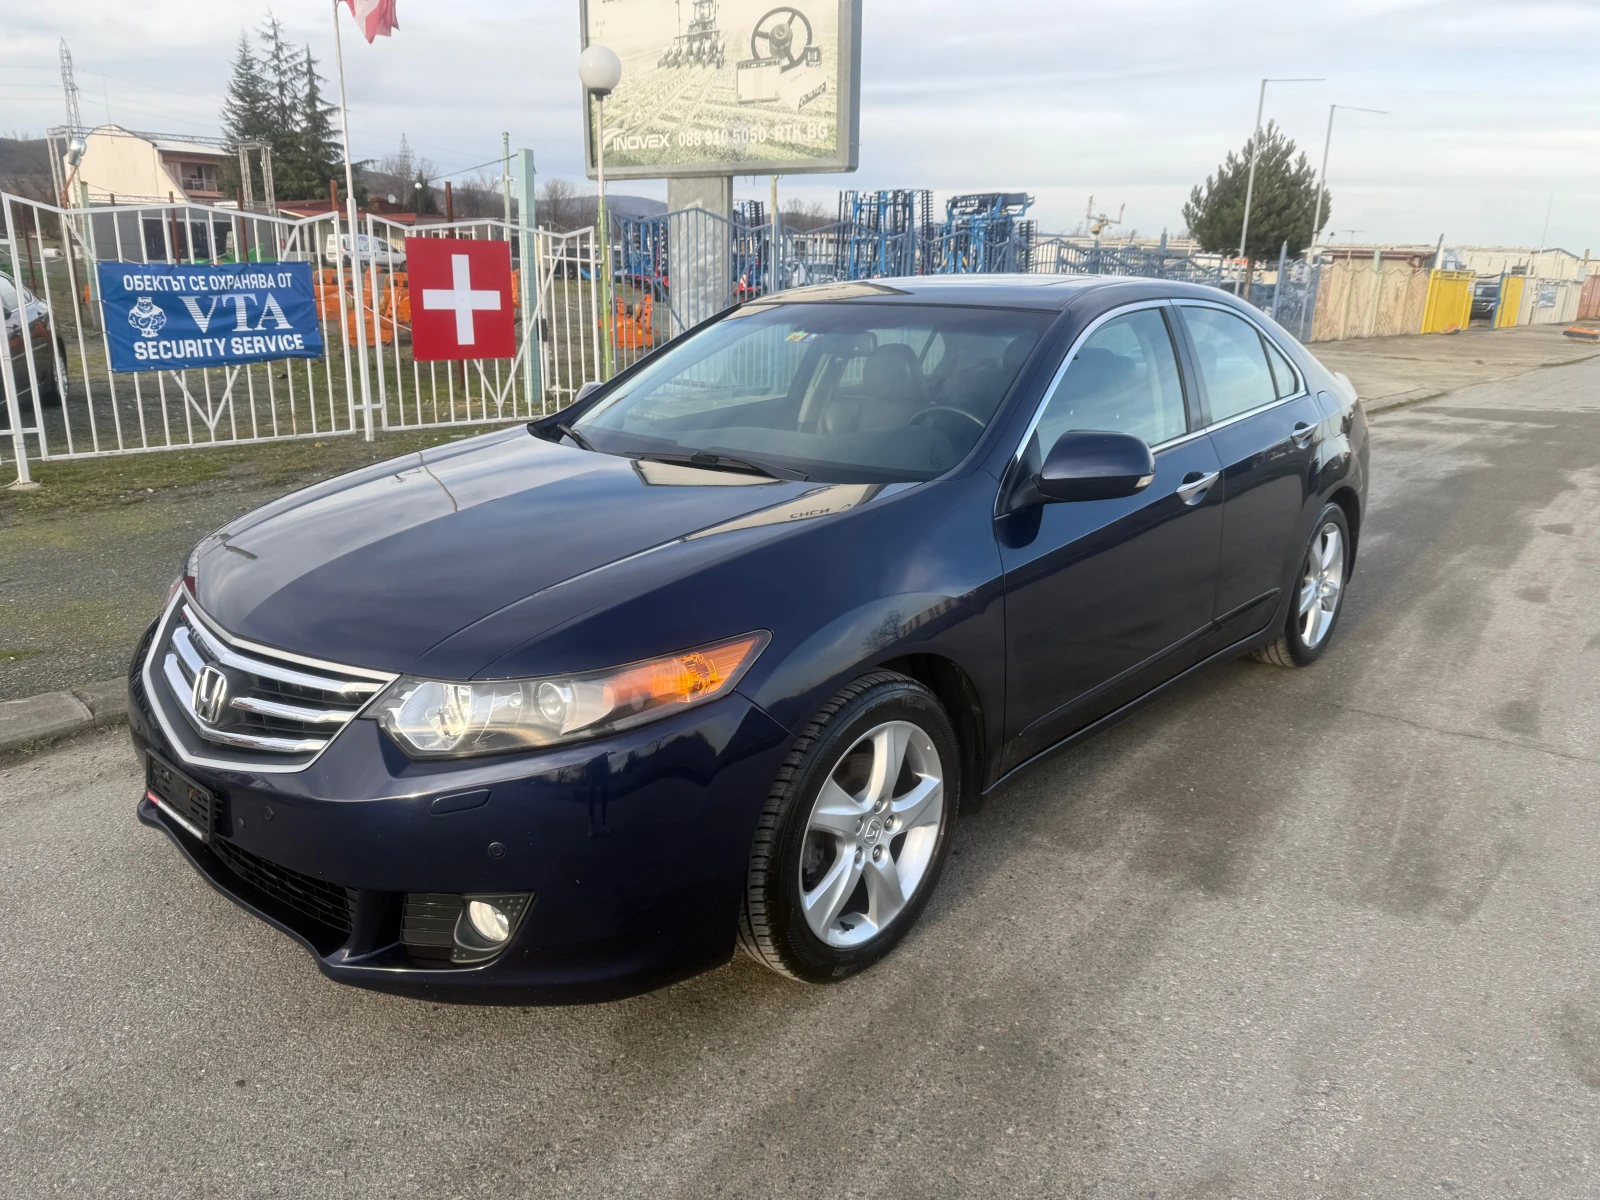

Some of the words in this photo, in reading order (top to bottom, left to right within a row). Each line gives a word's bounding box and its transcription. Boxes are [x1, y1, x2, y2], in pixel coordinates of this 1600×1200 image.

[613, 132, 671, 151] INOVEX
[678, 132, 702, 147] 088
[706, 129, 729, 145] 910
[123, 275, 186, 291] ОБЕКТЪТ
[189, 276, 208, 291] СЕ
[209, 273, 276, 291] ОХРАНЯВА
[277, 272, 293, 289] ОТ
[177, 291, 294, 334] VTA
[133, 337, 226, 360] SECURITY
[231, 333, 305, 355] SERVICE
